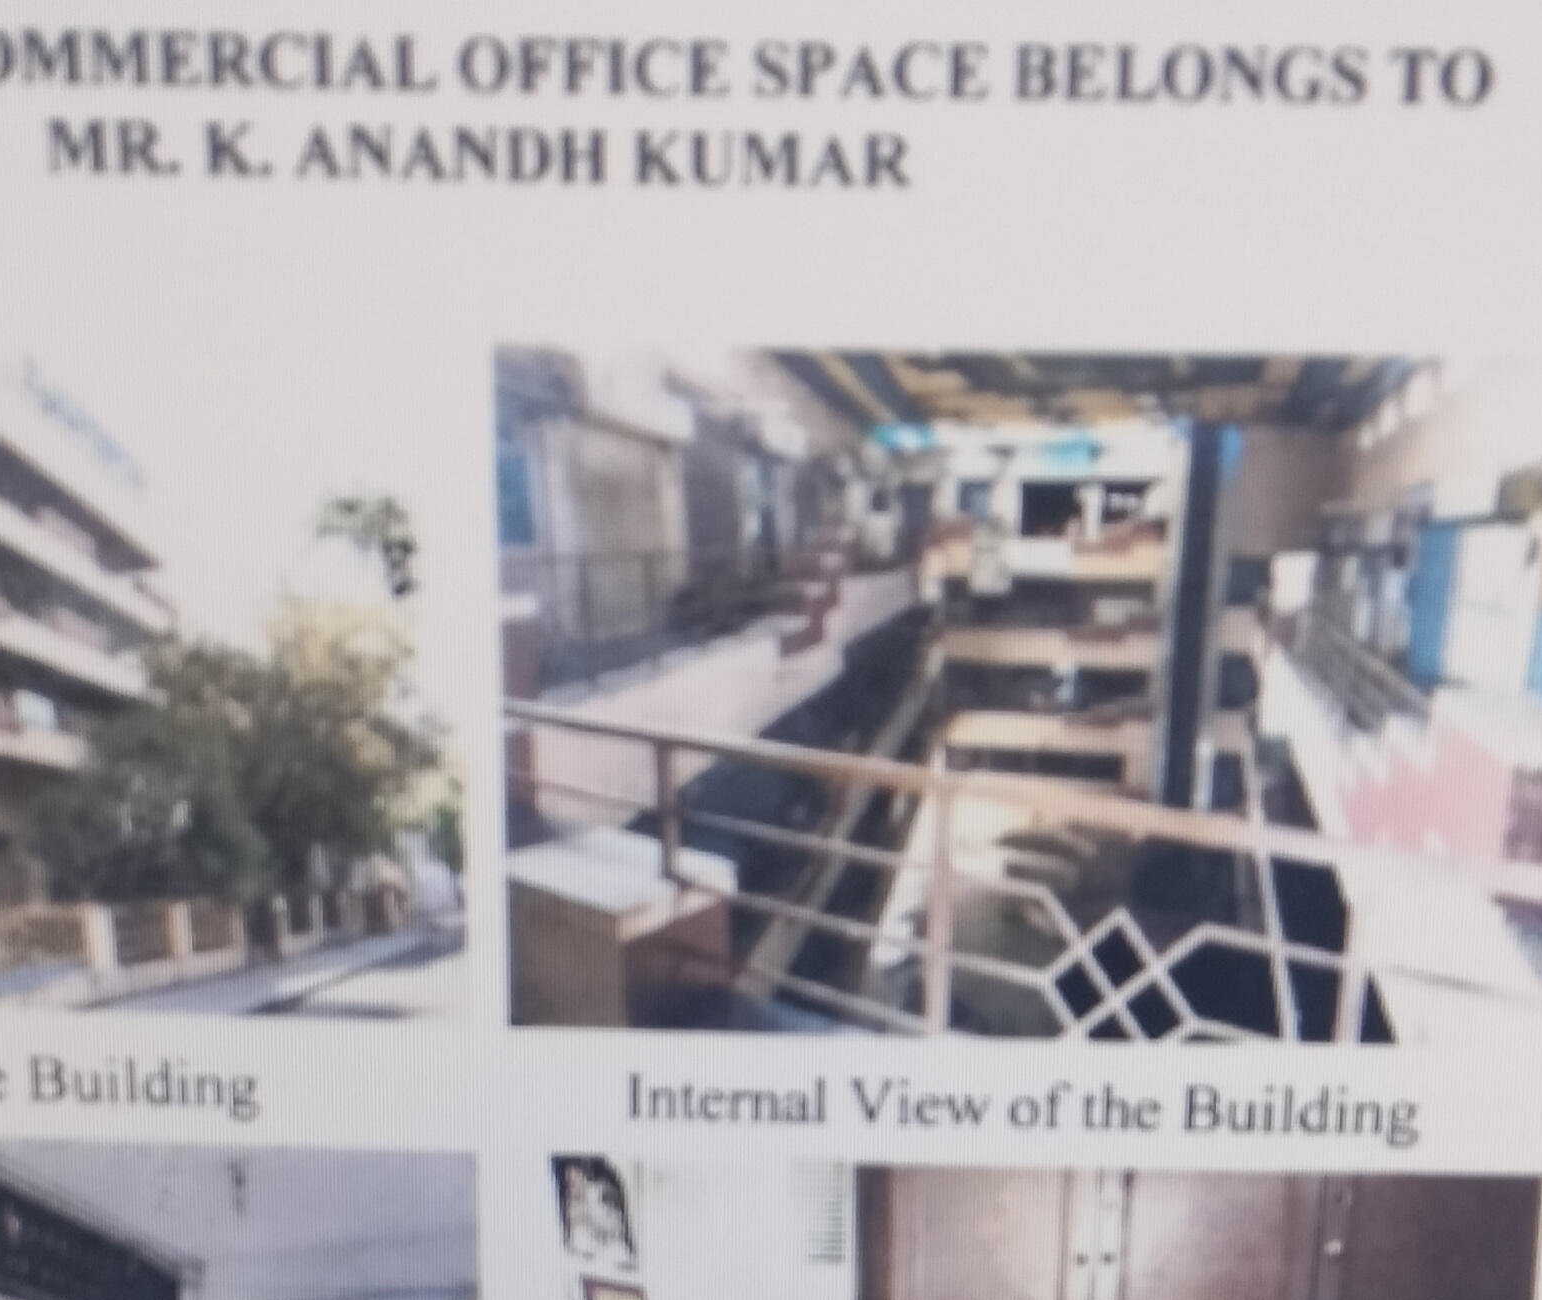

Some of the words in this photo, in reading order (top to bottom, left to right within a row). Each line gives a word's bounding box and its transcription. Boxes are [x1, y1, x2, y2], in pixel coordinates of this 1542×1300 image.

[457, 37, 726, 97] OFFICE
[754, 42, 986, 100] SPACE
[1016, 44, 1367, 103] BELONGS
[1393, 48, 1494, 105] TO
[49, 118, 179, 175] MR.
[206, 122, 271, 177] K.
[298, 124, 606, 184] ANANDH
[635, 130, 908, 187] KUMAR
[29, 1055, 260, 1123] Building
[628, 1072, 826, 1125] Internal
[850, 1077, 988, 1127] View
[1007, 1082, 1071, 1130] of
[1082, 1083, 1162, 1132] the
[1183, 1084, 1419, 1149] Building
